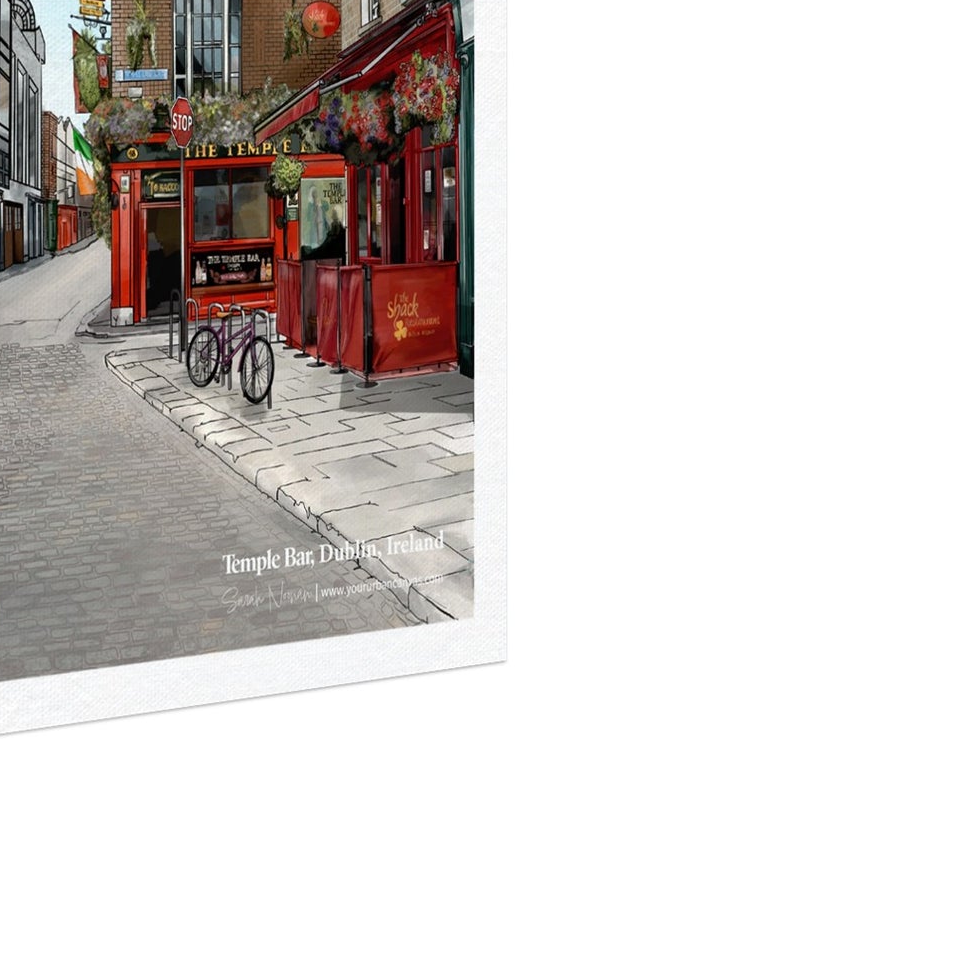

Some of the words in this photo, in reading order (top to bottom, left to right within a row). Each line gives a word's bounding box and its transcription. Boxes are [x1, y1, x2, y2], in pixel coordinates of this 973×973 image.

[172, 113, 193, 131] STOP
[222, 549, 282, 575] Temple
[284, 546, 316, 569] Bar,
[319, 541, 383, 564] Dublin,
[386, 531, 445, 556] Ireland
